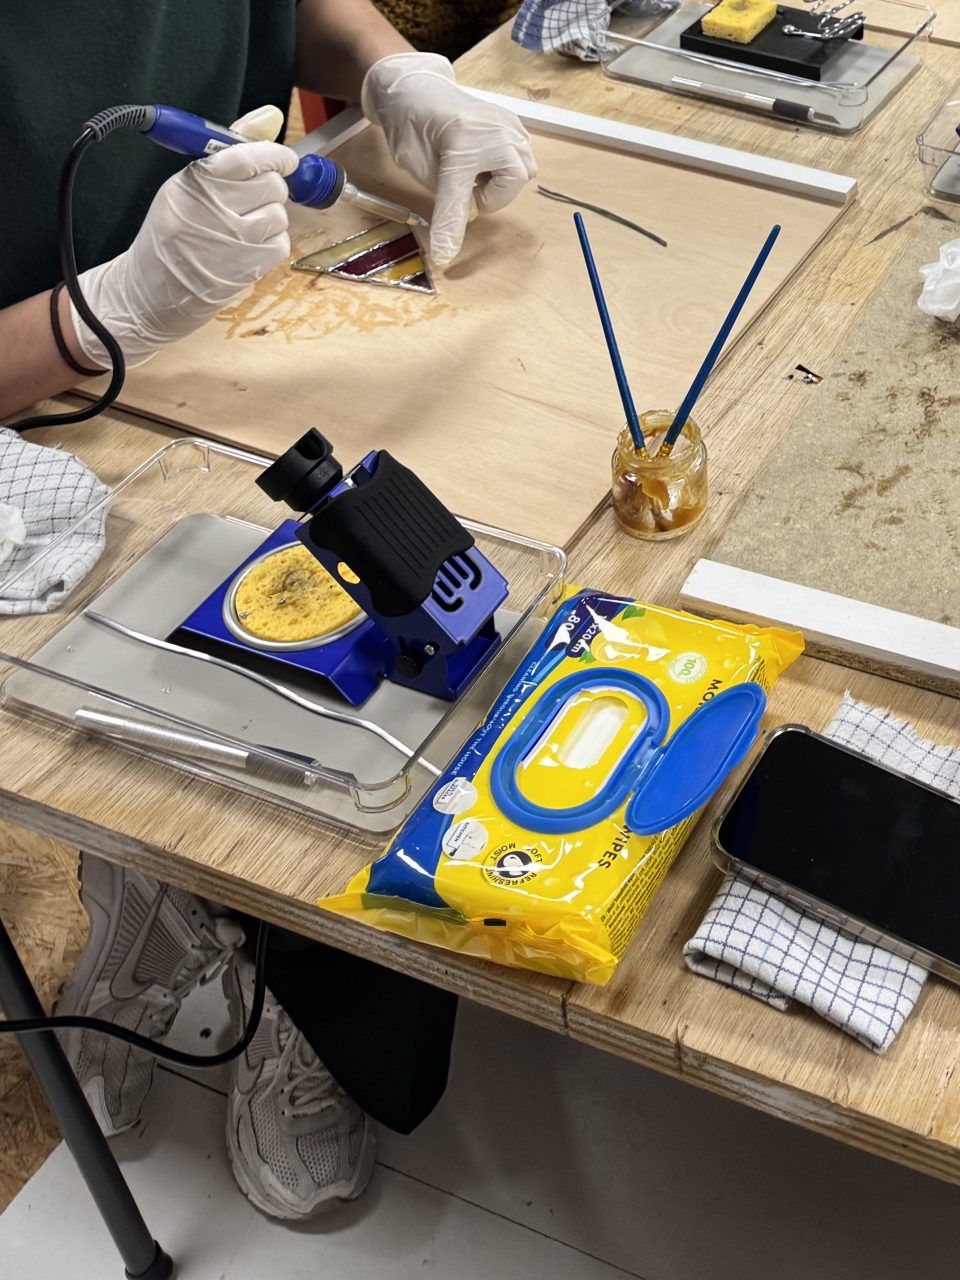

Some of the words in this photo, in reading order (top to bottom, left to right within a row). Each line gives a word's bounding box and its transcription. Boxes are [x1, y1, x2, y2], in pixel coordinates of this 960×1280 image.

[469, 737, 482, 751] THE
[451, 752, 471, 776] HOUSE
[490, 842, 516, 861] MOIST
